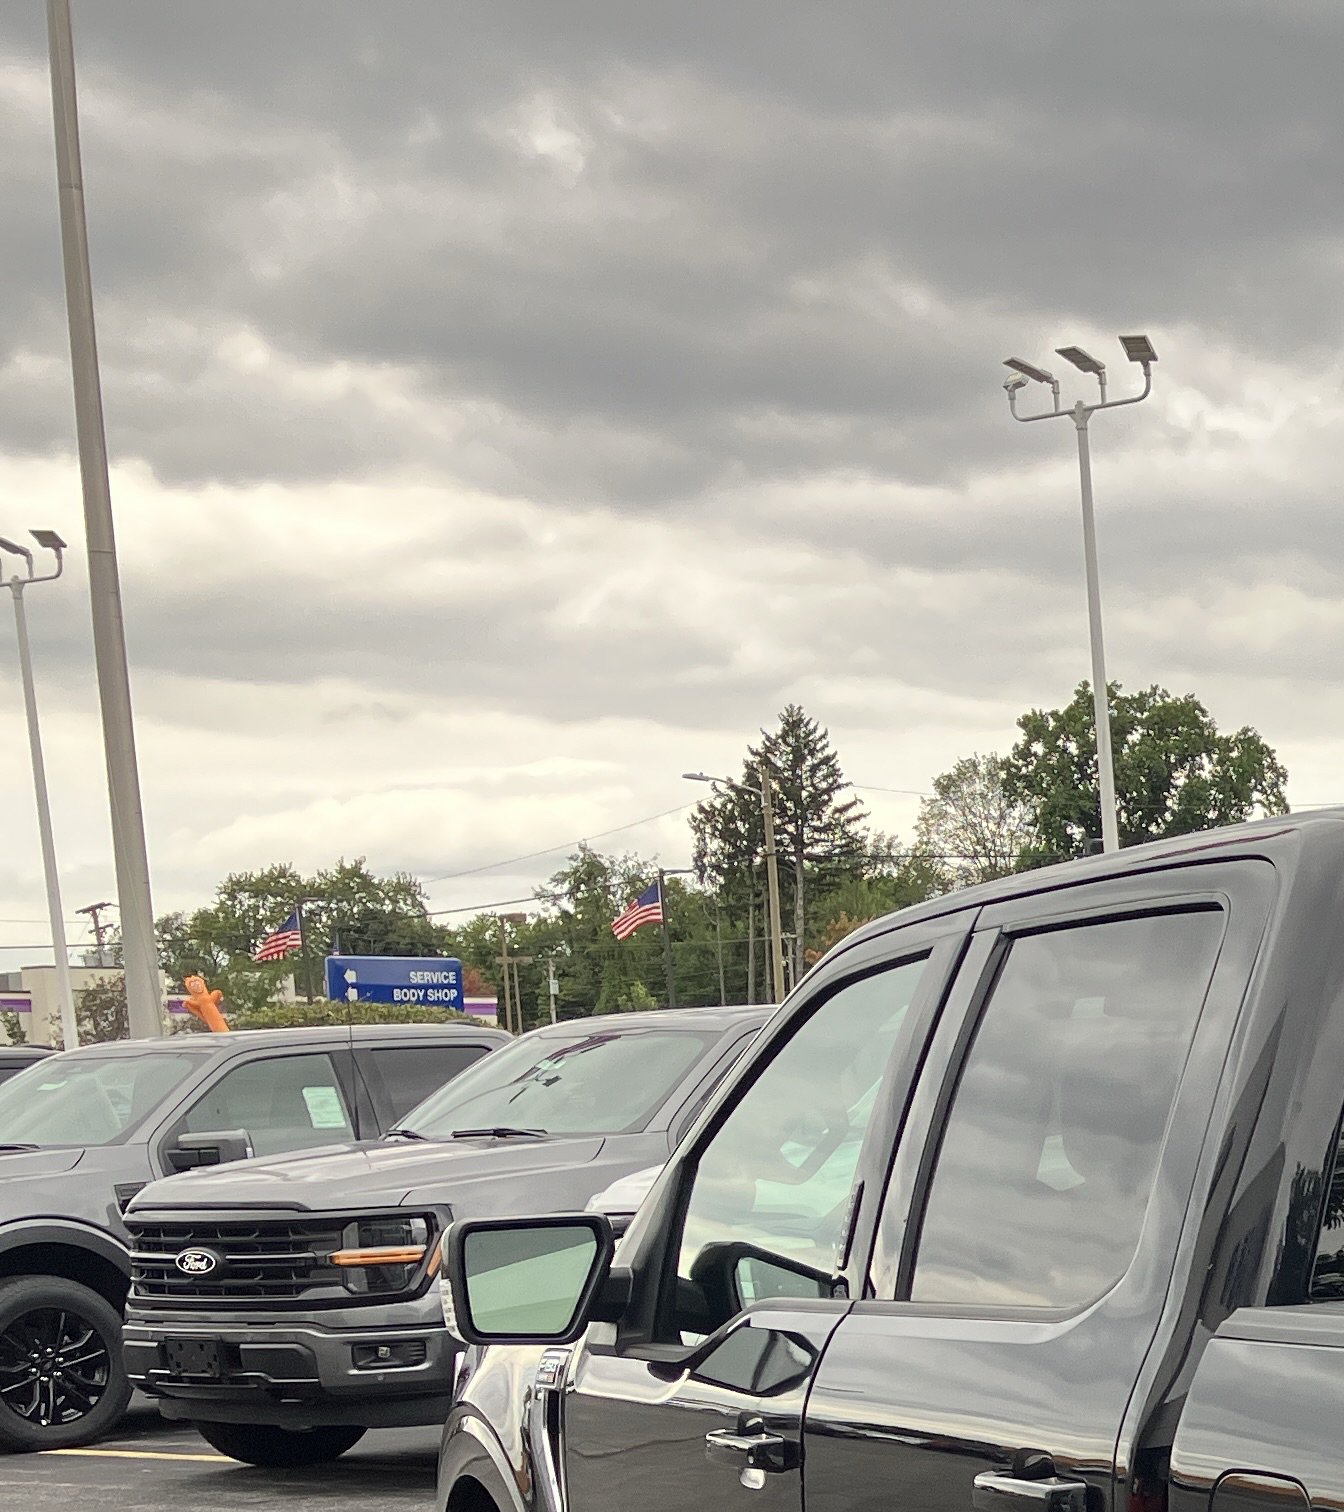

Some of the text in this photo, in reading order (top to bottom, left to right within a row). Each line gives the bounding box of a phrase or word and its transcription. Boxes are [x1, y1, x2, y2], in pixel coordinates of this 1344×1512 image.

[409, 971, 457, 984] SERVICE
[393, 988, 458, 1001] BODY SHOP
[183, 1254, 208, 1270] Ford
